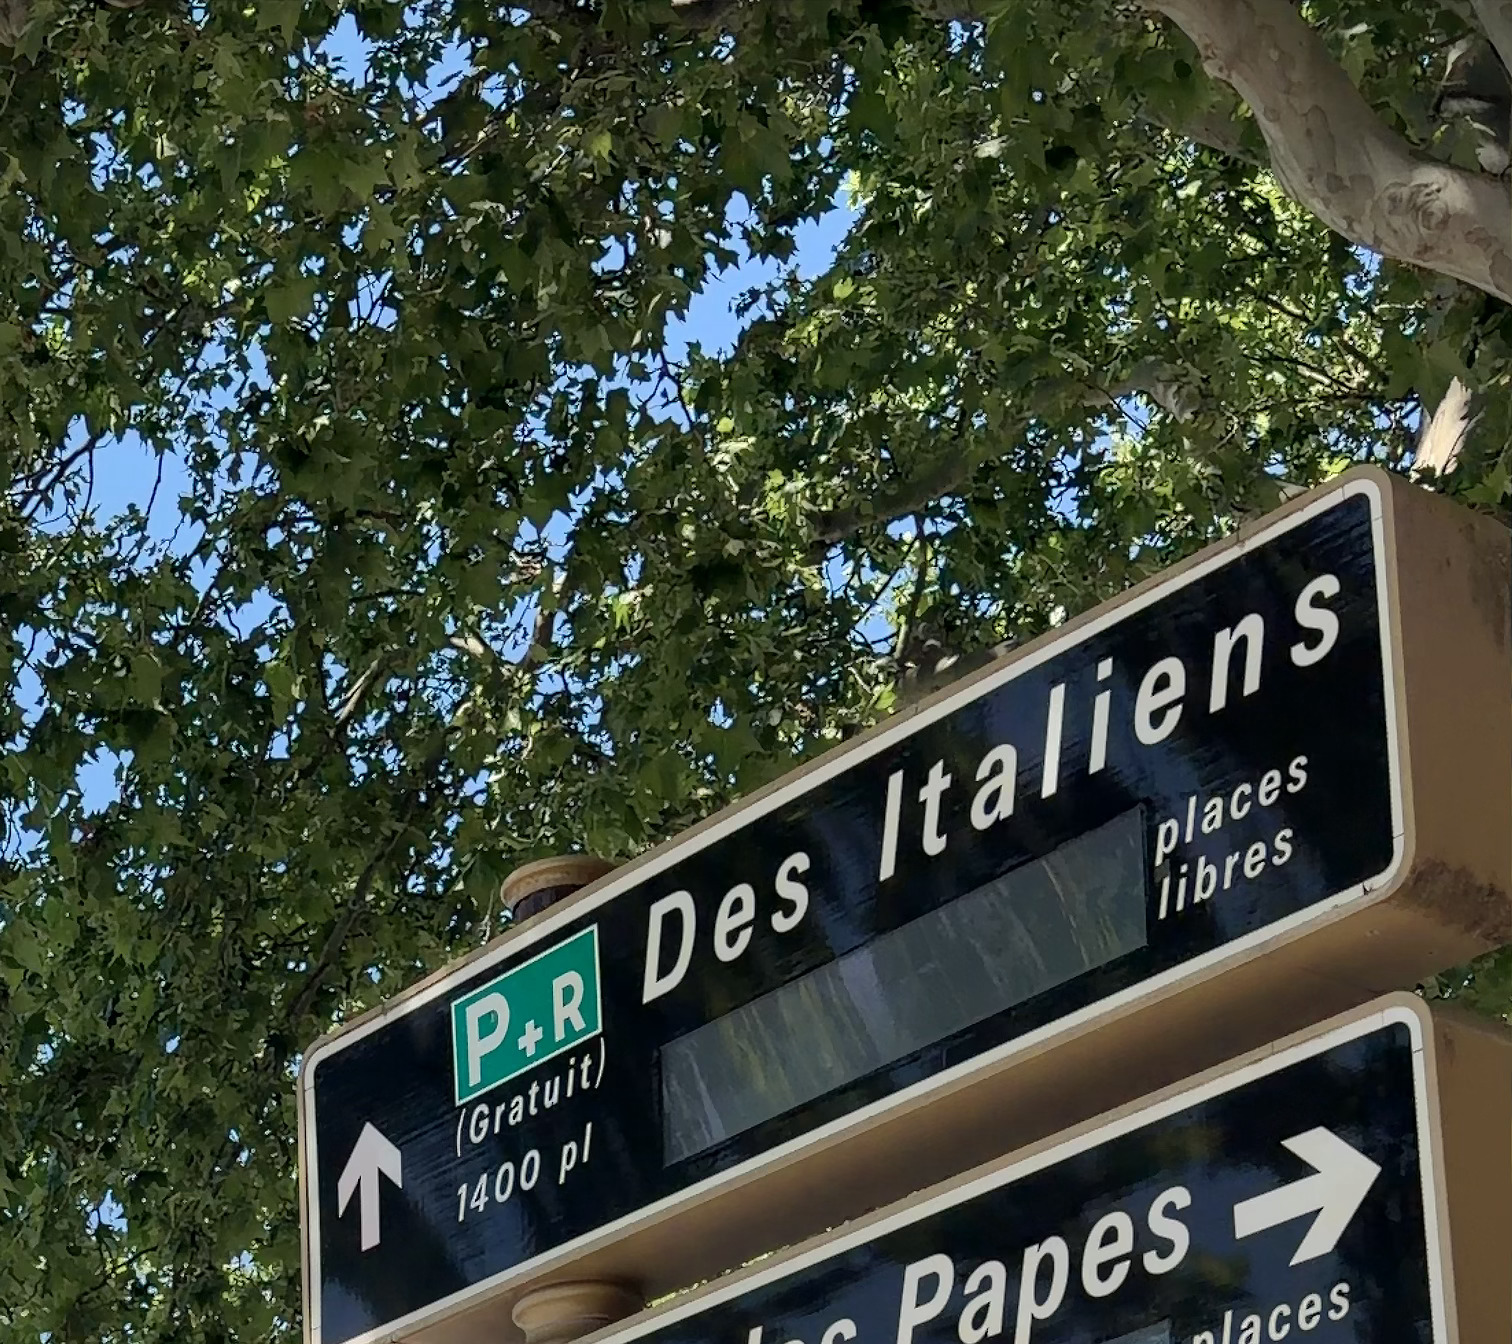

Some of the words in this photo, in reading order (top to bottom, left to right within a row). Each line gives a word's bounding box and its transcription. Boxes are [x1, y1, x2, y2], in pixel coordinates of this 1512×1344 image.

[641, 851, 811, 1004] Des
[878, 573, 1342, 882] Italiens
[1154, 754, 1309, 867] places
[1158, 827, 1294, 921] libres
[465, 969, 587, 1088] P+R
[455, 1037, 606, 1157] (Gratuit)
[456, 1148, 541, 1223] 1400
[559, 1122, 593, 1185] pl
